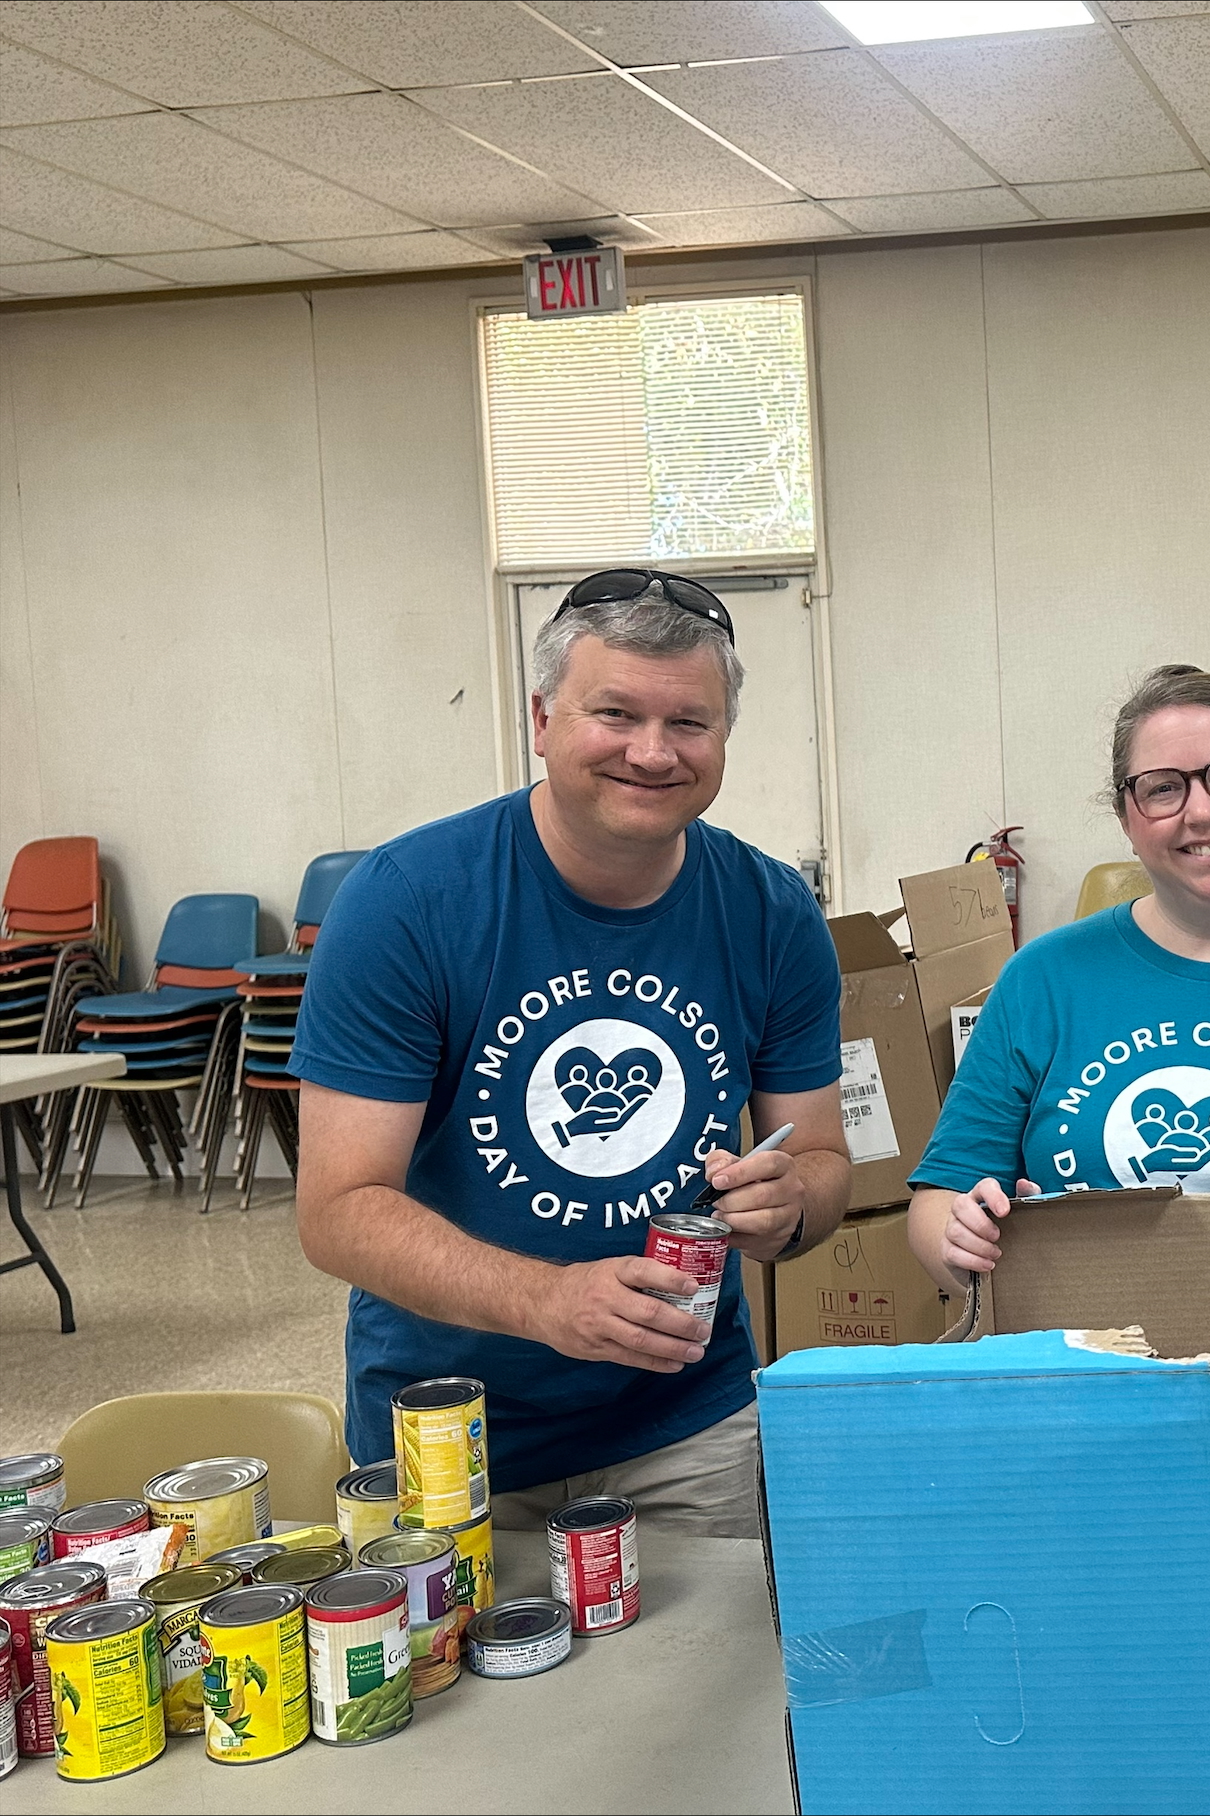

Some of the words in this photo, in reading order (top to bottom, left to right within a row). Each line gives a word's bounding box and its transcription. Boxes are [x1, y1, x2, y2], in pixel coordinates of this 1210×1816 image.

[538, 255, 601, 311] EXIT
[474, 968, 592, 1080] MOORE
[607, 969, 730, 1082] COLSON
[1057, 1021, 1178, 1114] MOORE
[469, 1115, 529, 1189] DAY
[531, 1191, 589, 1227] OF
[604, 1113, 728, 1229] IMPACT
[824, 1323, 891, 1339] FRAGILE
[451, 1429, 463, 1438] 60
[170, 1512, 194, 1520] Facts
[92, 1641, 120, 1652] Nutrition
[94, 1665, 122, 1676] Calories
[129, 1655, 139, 1666] 60
